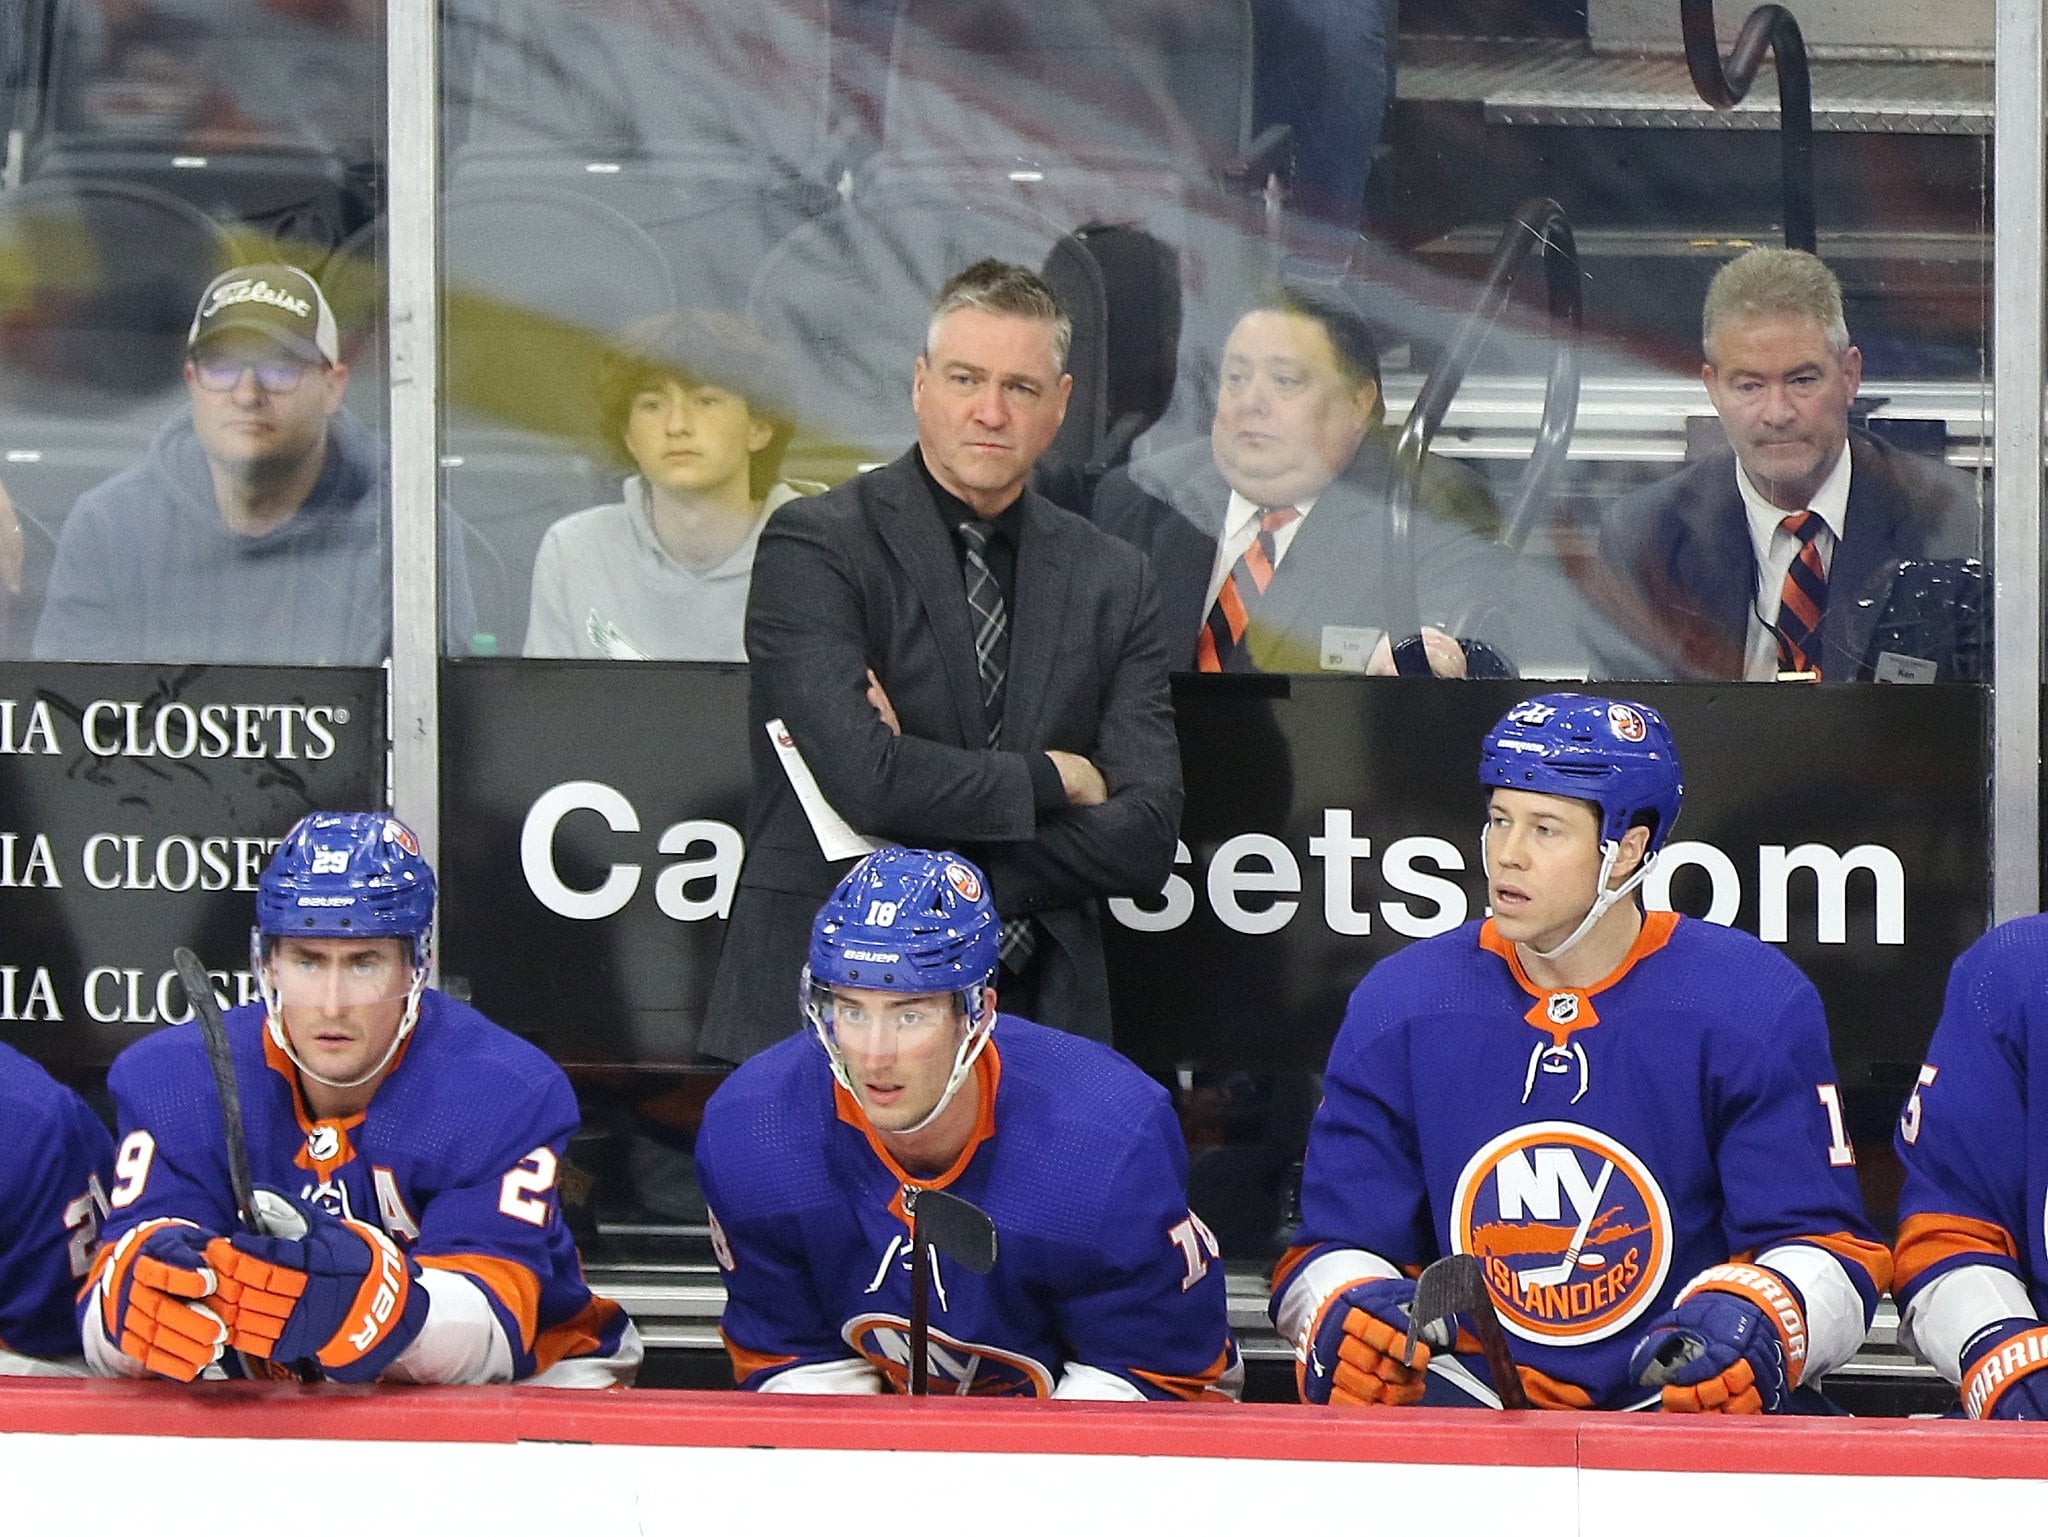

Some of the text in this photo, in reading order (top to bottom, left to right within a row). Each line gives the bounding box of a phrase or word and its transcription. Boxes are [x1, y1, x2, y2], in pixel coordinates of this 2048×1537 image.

[311, 849, 349, 874] 29
[864, 901, 897, 927] 18
[843, 949, 899, 964] BAUER
[110, 1129, 156, 1208] 9
[373, 1166, 420, 1241] A
[1485, 1246, 1640, 1320] ISLANDERS
